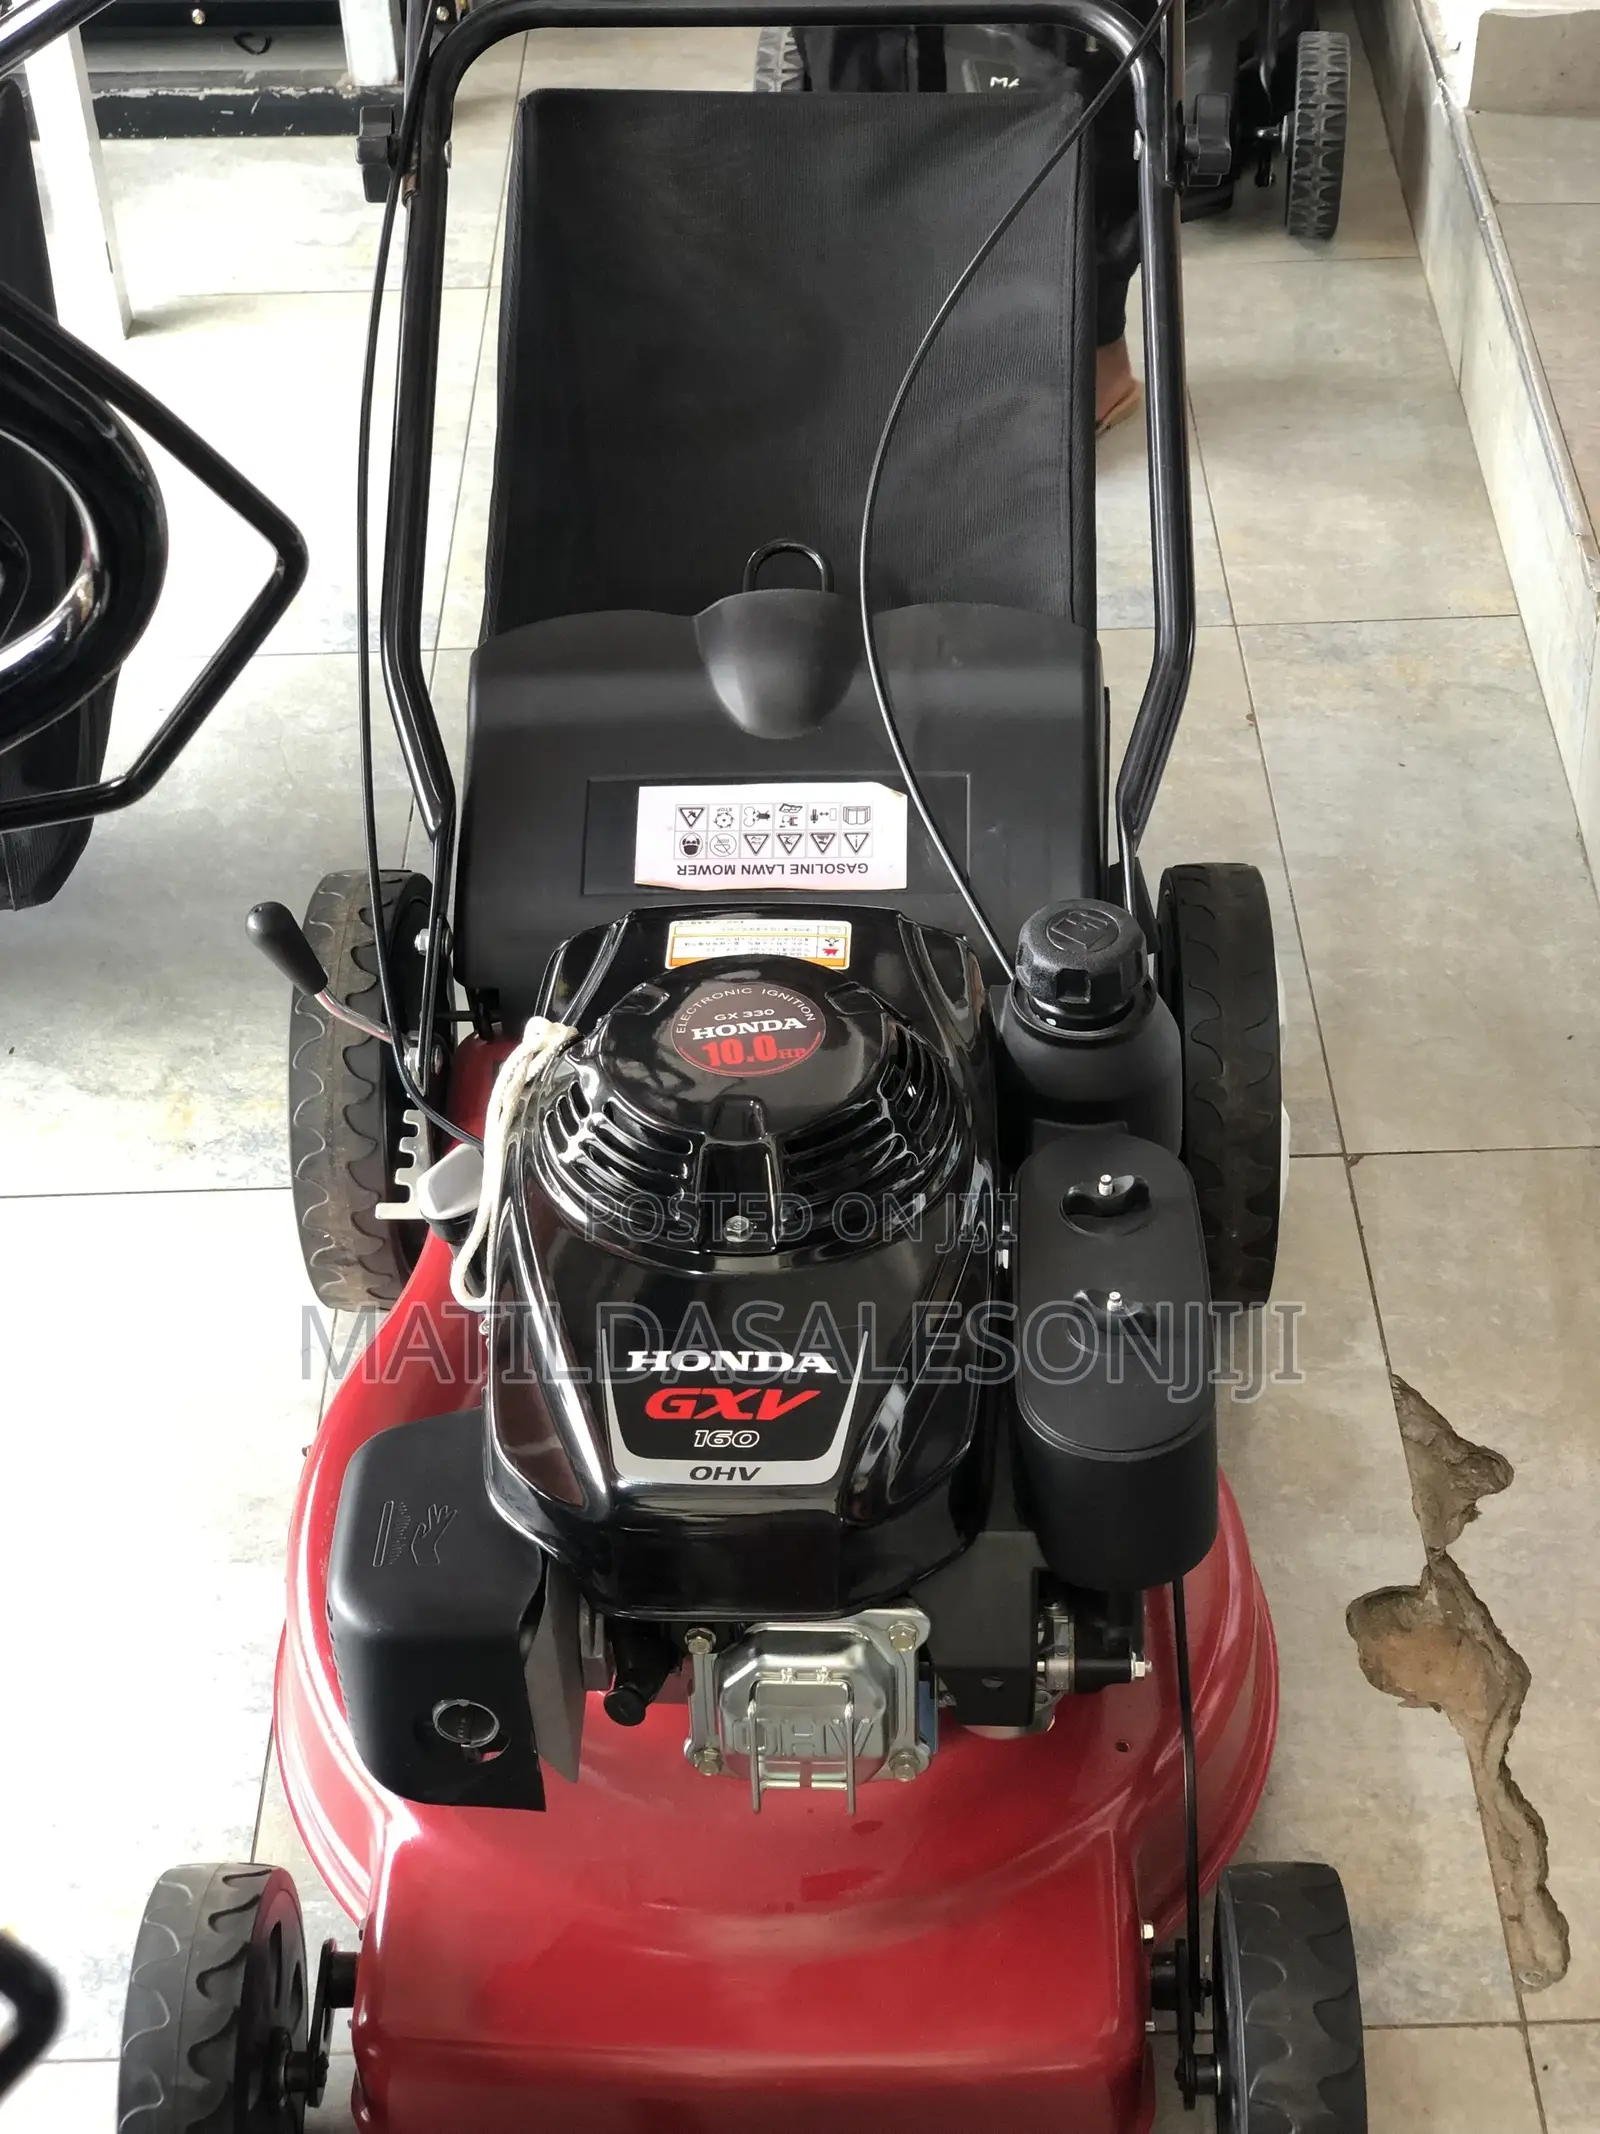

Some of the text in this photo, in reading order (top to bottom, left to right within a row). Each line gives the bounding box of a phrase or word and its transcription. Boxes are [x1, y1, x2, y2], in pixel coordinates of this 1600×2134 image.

[676, 863, 869, 876] GASOLINE LAWN MOWER
[676, 987, 816, 1034] ELECTRONIC IGNITION
[714, 1008, 775, 1021] GX 330
[691, 1017, 807, 1040] HONDA
[702, 1034, 778, 1067] 10.0
[626, 1350, 837, 1374] HONDA
[644, 1387, 821, 1420] GXV
[693, 1429, 760, 1449] 160
[689, 1466, 761, 1482] OHV
